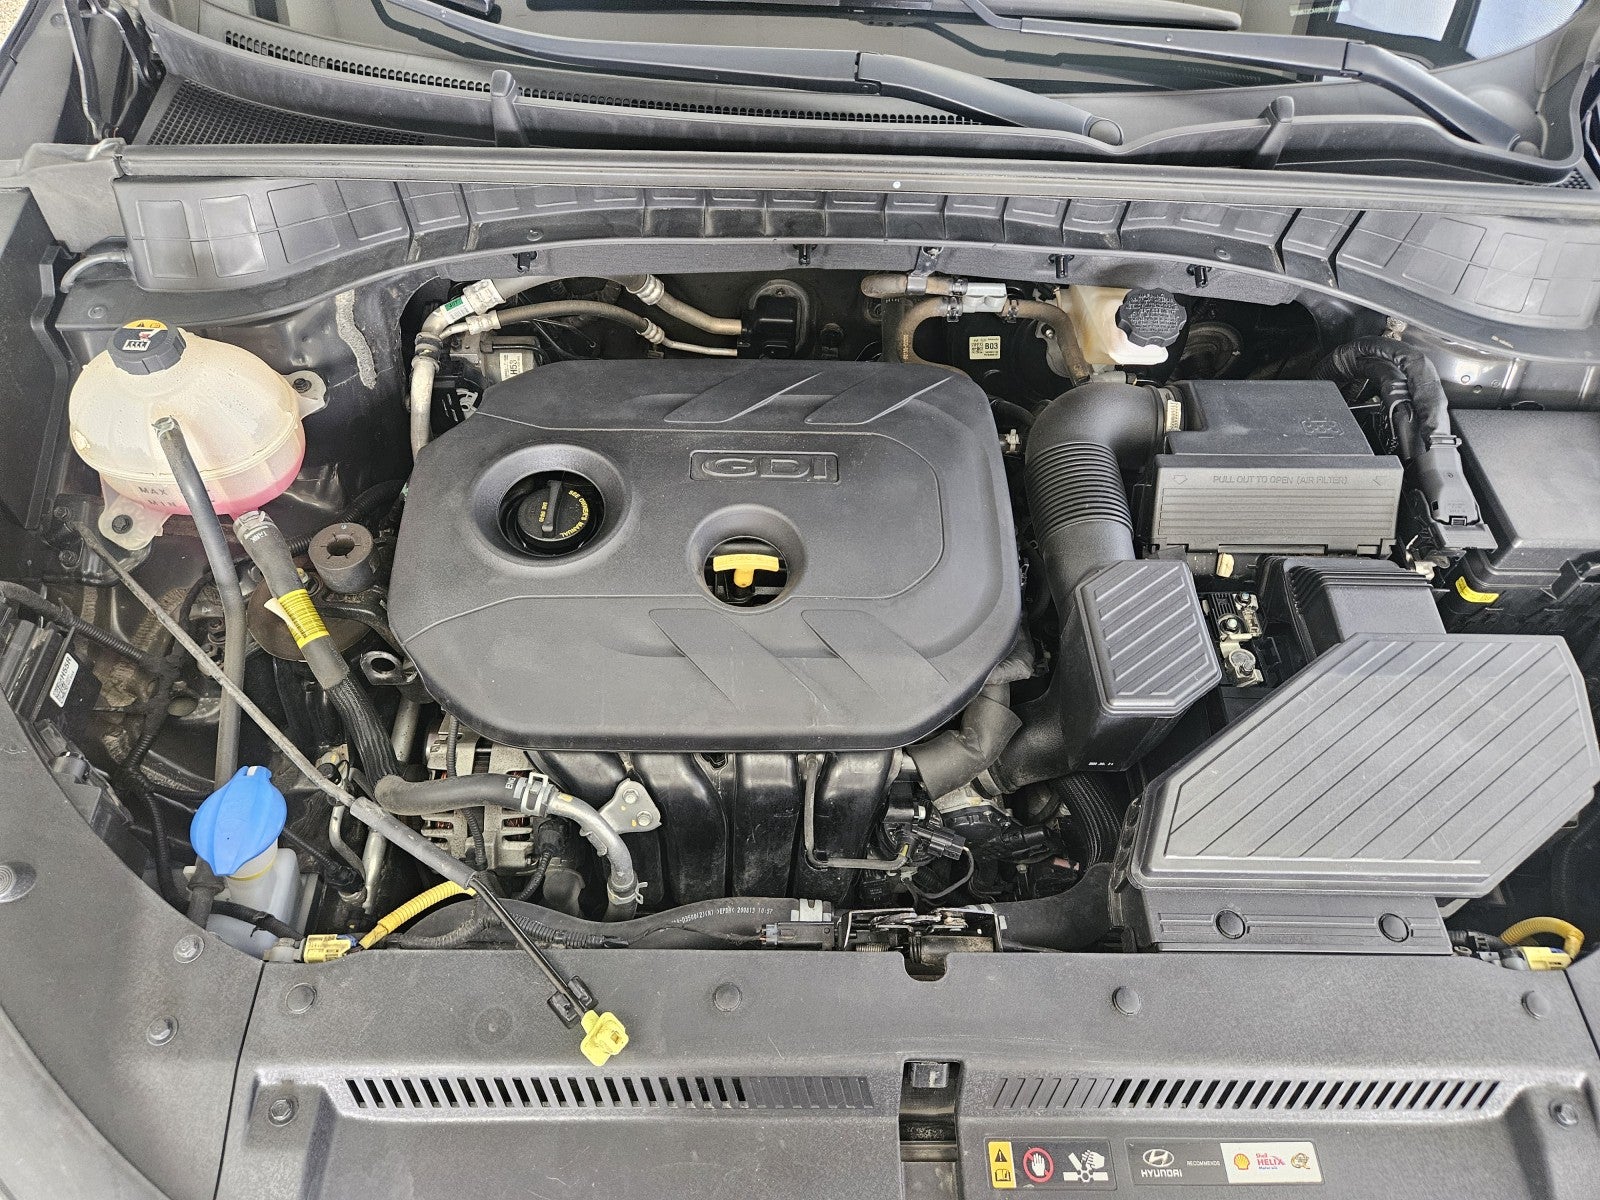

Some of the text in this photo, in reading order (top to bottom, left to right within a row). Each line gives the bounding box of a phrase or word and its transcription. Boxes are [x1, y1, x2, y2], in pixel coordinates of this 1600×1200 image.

[984, 342, 998, 350] B03
[701, 457, 828, 480] GDI
[1212, 475, 1348, 486] PULL OUT TO OPEN (AIR FILTER)
[138, 486, 168, 496] MAX
[568, 490, 580, 499] SEE
[147, 499, 177, 507] MIN
[560, 521, 585, 537] MANUAL
[1257, 1158, 1285, 1166] HELIX
[1140, 1169, 1183, 1178] HYUNDAI
